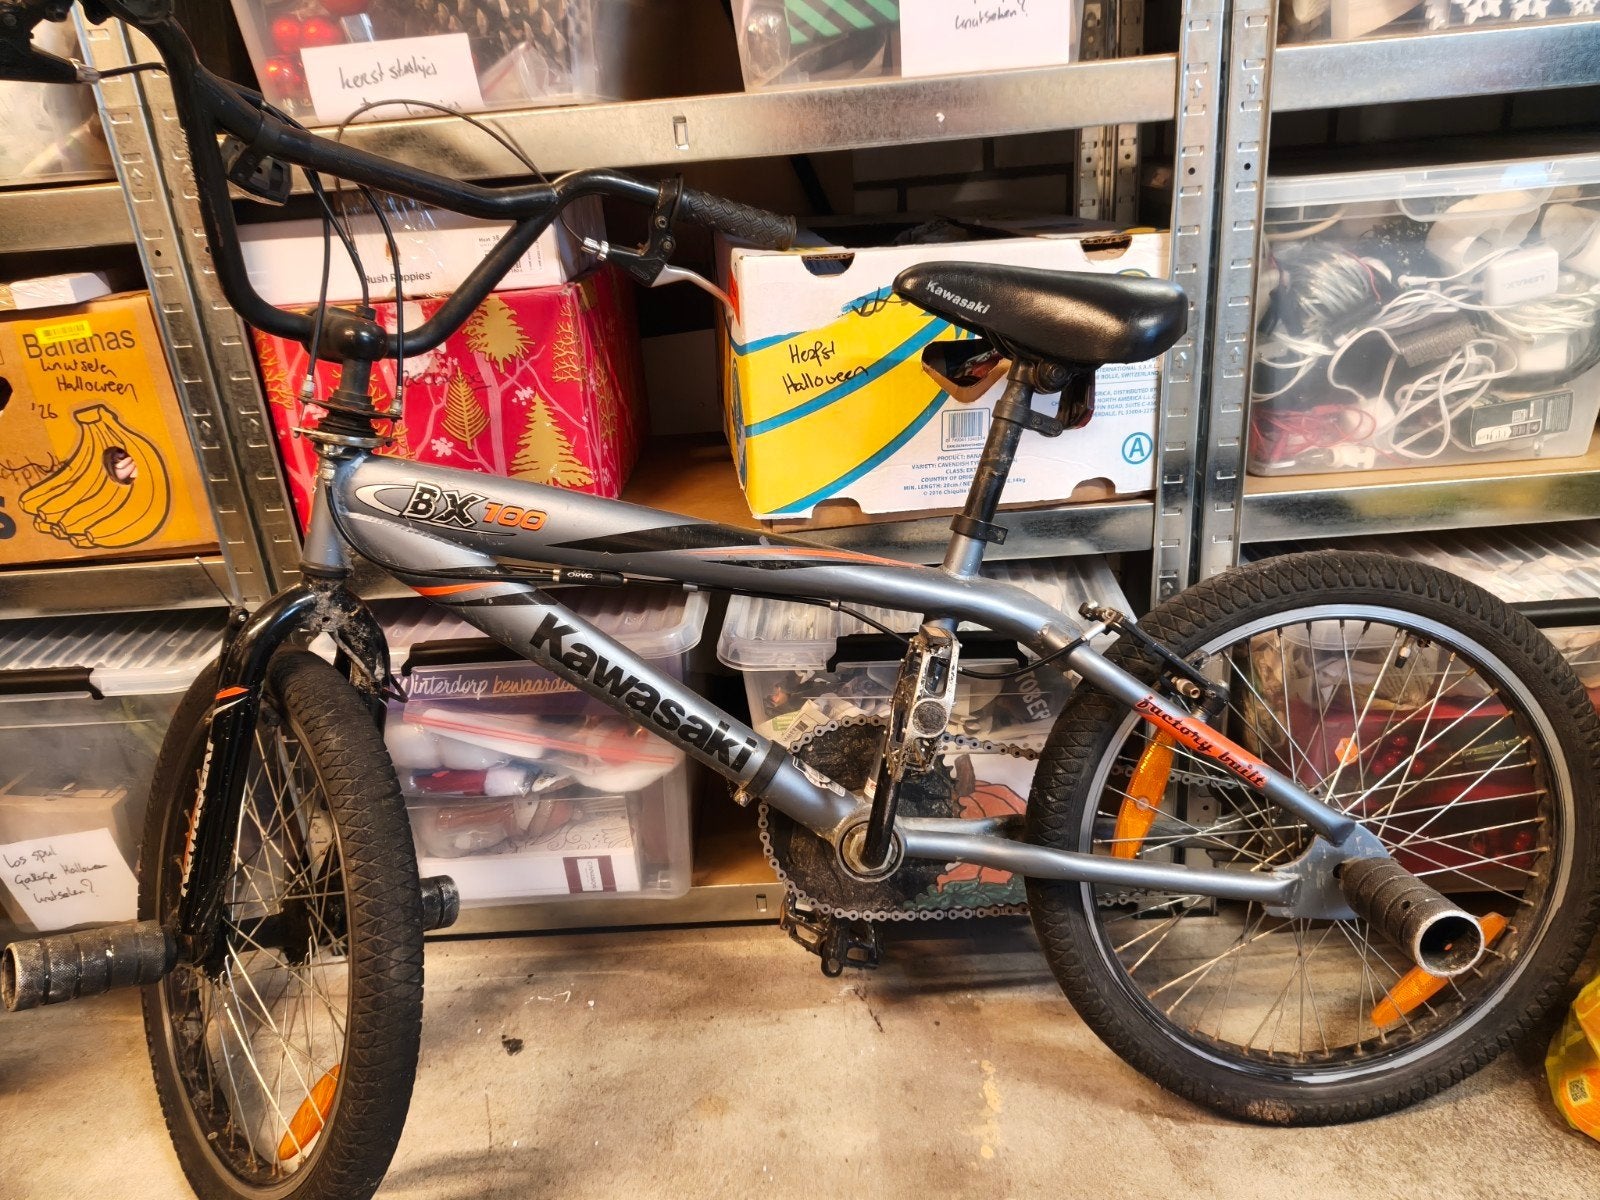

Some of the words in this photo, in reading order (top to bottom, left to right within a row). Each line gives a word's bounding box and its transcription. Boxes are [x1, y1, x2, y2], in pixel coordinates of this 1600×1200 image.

[391, 271, 430, 283] Pppies
[925, 280, 991, 314] Kawasaki
[22, 329, 136, 359] Bananas
[56, 374, 138, 403] Halloween
[782, 366, 868, 394] Halloween
[921, 475, 949, 483] COUNTRY
[402, 481, 489, 528] BX
[483, 501, 549, 531] 100
[395, 674, 489, 700] Winterdorp
[528, 611, 759, 774] Kawasaki
